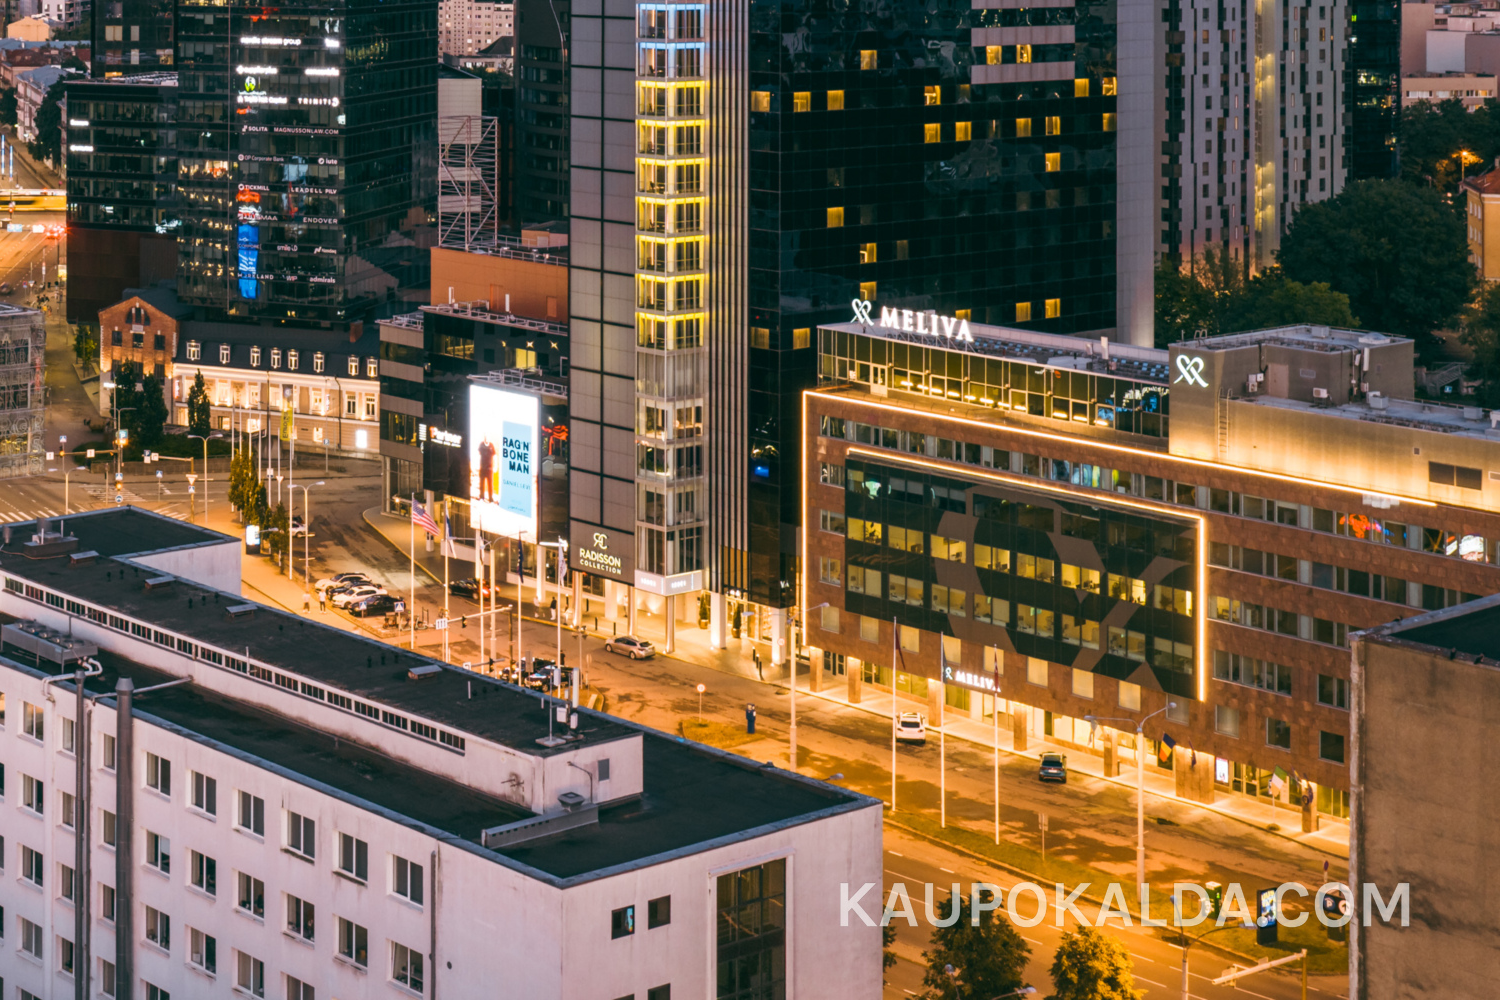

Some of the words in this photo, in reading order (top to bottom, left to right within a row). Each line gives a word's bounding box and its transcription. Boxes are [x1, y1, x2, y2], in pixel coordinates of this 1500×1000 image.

[283, 38, 301, 46] group
[880, 305, 974, 342] MELIVA
[503, 448, 529, 463] BONE
[509, 460, 529, 474] MAN
[580, 548, 621, 567] RADISSON
[580, 559, 621, 575] COLLECTION
